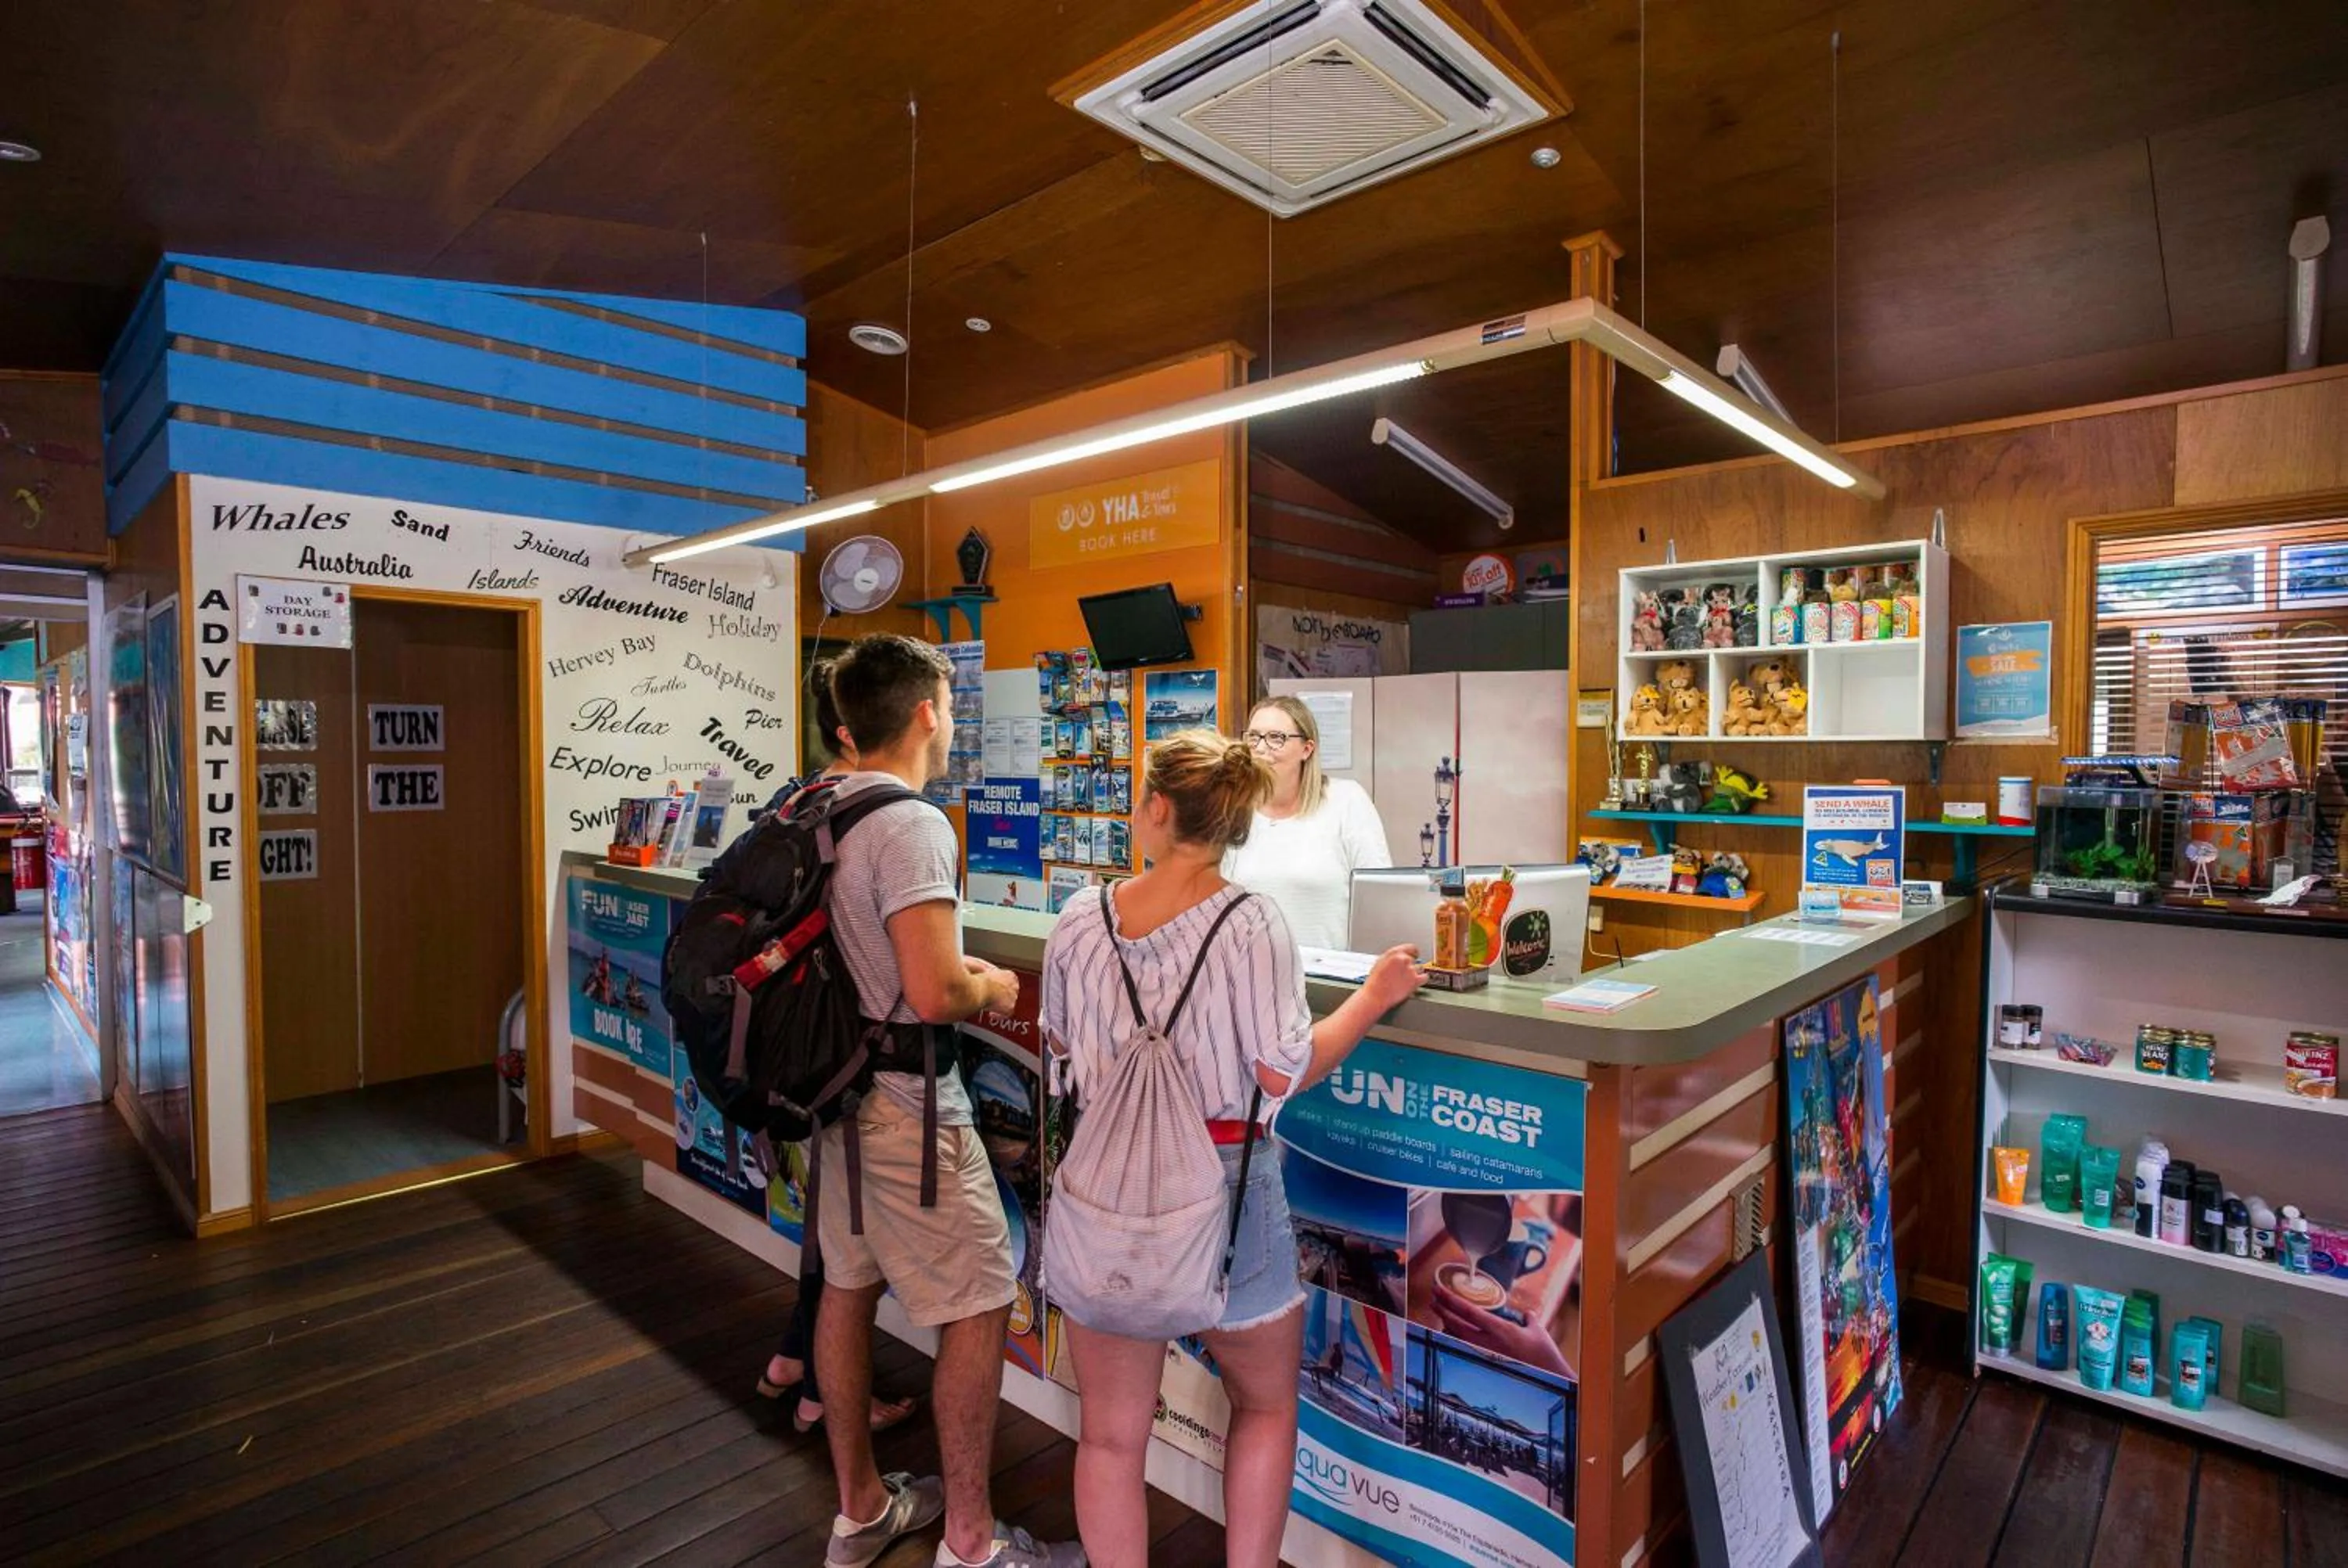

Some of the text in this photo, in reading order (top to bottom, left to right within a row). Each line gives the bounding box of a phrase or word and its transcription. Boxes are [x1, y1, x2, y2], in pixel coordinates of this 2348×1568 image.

[211, 503, 351, 532] Whales
[391, 509, 451, 542] Sand
[1102, 493, 1139, 525] YHA
[513, 530, 590, 568] Friends
[1079, 527, 1158, 552] BOOK HERE
[297, 545, 414, 580] Australia
[466, 568, 539, 590] Islands
[284, 595, 313, 607] DAY
[558, 584, 690, 624] Adventure
[652, 562, 755, 612] Fraser Island
[265, 606, 331, 619] STORAGE
[707, 613, 783, 643] Holiday
[548, 634, 657, 678] Hervey Bay
[682, 651, 777, 703] Dolphins
[374, 711, 439, 745] TURN
[570, 697, 672, 735] Relax
[744, 708, 783, 730] Pier
[199, 588, 234, 882] ADVENTURE
[699, 716, 775, 781] Travel
[549, 746, 652, 782] Explore
[257, 771, 311, 808] FF
[374, 771, 439, 806] THE
[984, 785, 1022, 800] REMOTE
[1843, 800, 1852, 808] A
[1852, 799, 1890, 808] WHALE
[968, 800, 1040, 816] FRASER ISLAND
[260, 837, 312, 873] GHT!
[582, 890, 618, 918] FUN
[594, 1008, 623, 1042] BOOK
[1331, 1066, 1405, 1116] UN
[1418, 1082, 1429, 1120] THE
[1432, 1084, 1543, 1127] FRASER
[1431, 1105, 1543, 1149] COAST
[1333, 1117, 1358, 1132] stand
[1371, 1127, 1403, 1144] paddle
[1405, 1135, 1437, 1153] boards
[1449, 1146, 1481, 1167] sailing
[1483, 1157, 1543, 1180] catamarans
[1398, 1148, 1424, 1164] bikes
[1458, 1163, 1478, 1178] and
[1480, 1169, 1504, 1185] food
